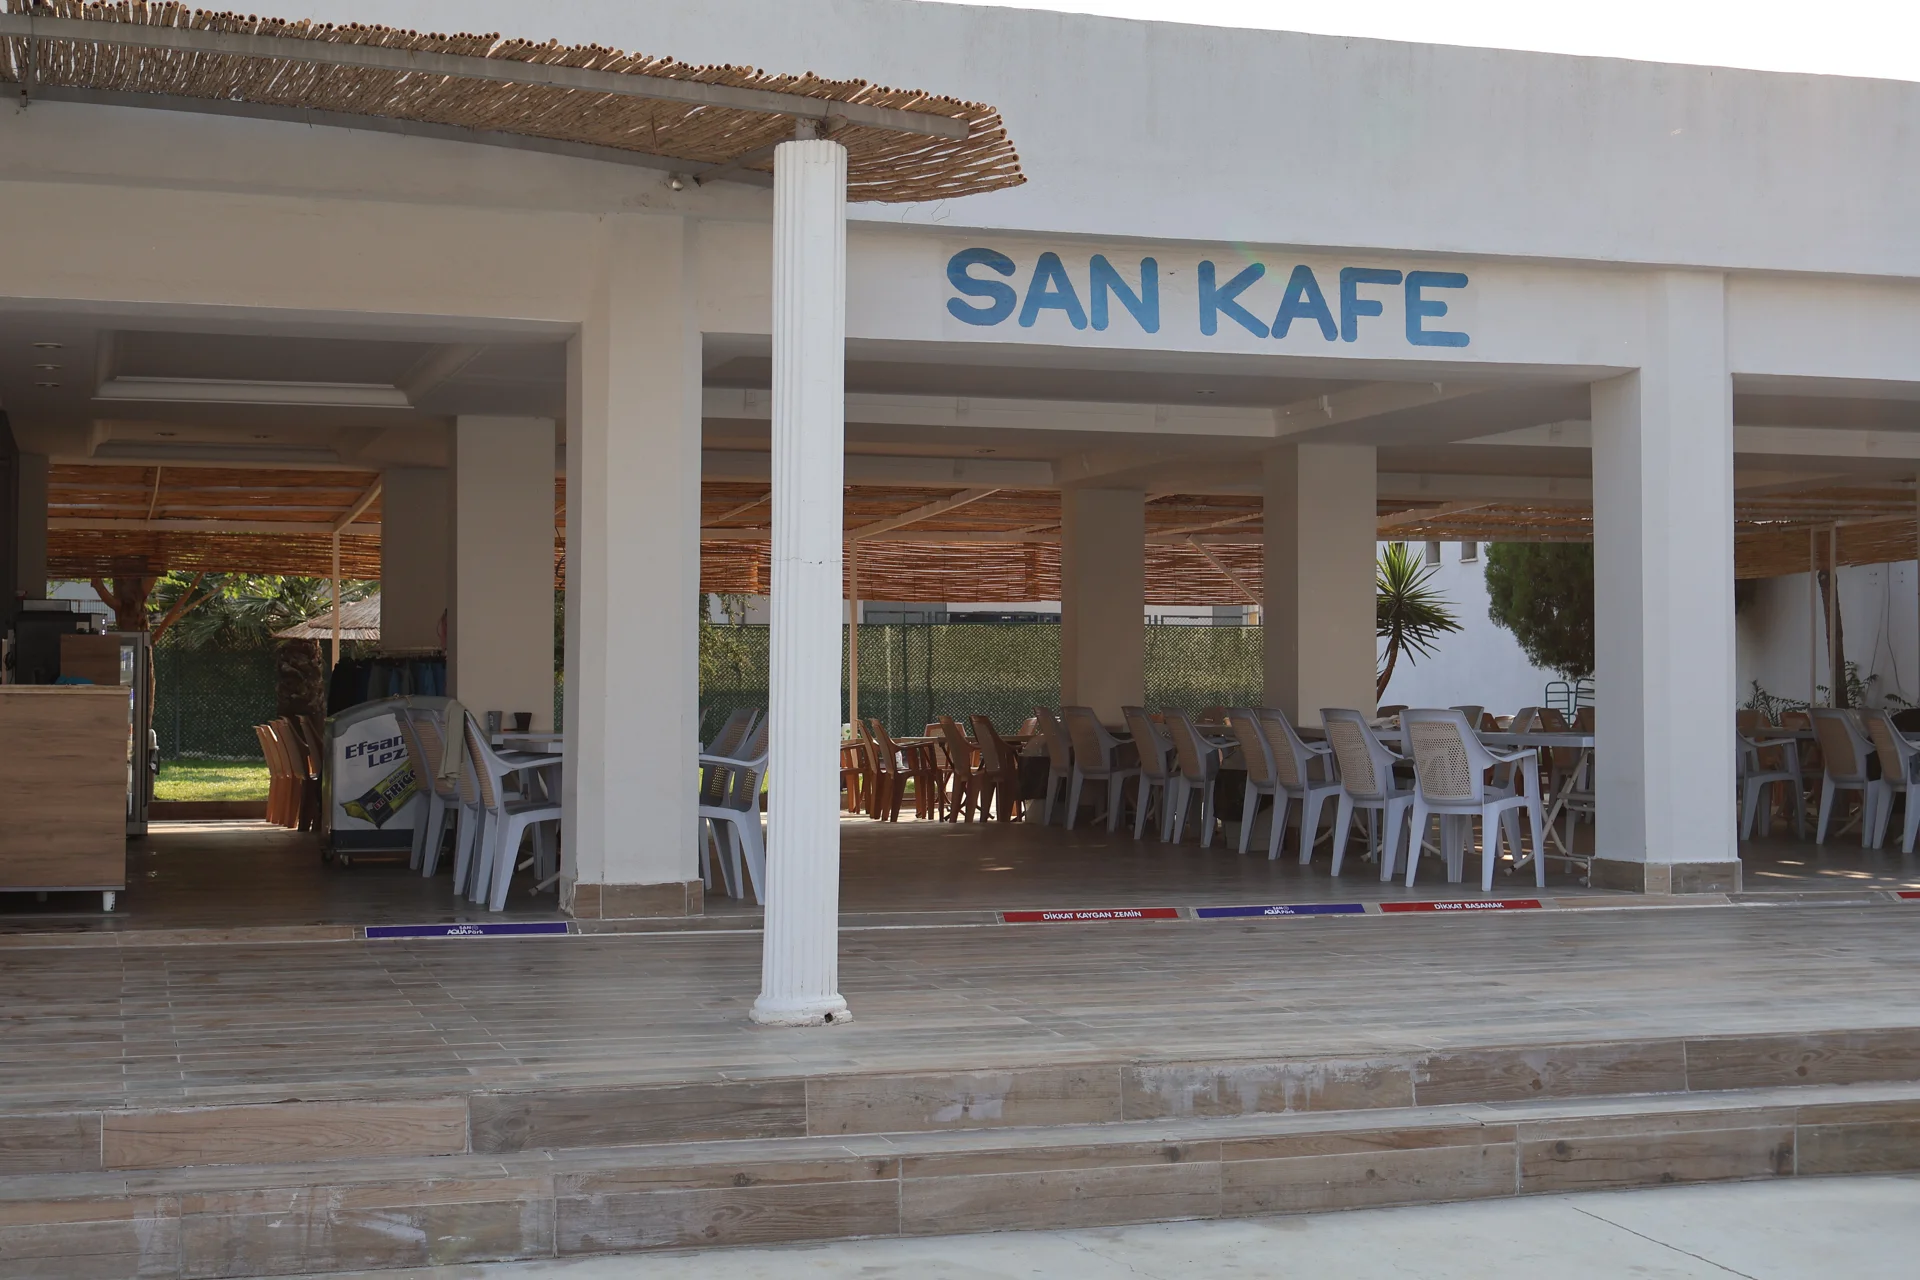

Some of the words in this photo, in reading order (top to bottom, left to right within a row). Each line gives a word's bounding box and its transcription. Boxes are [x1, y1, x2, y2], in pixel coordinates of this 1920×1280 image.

[947, 247, 1160, 334] SAN
[1198, 259, 1471, 348] KAFE
[368, 747, 409, 768] Lez
[1042, 911, 1074, 920] DİKKAT
[1076, 911, 1112, 919] KAYGAN
[1113, 909, 1142, 918] ZEMİN
